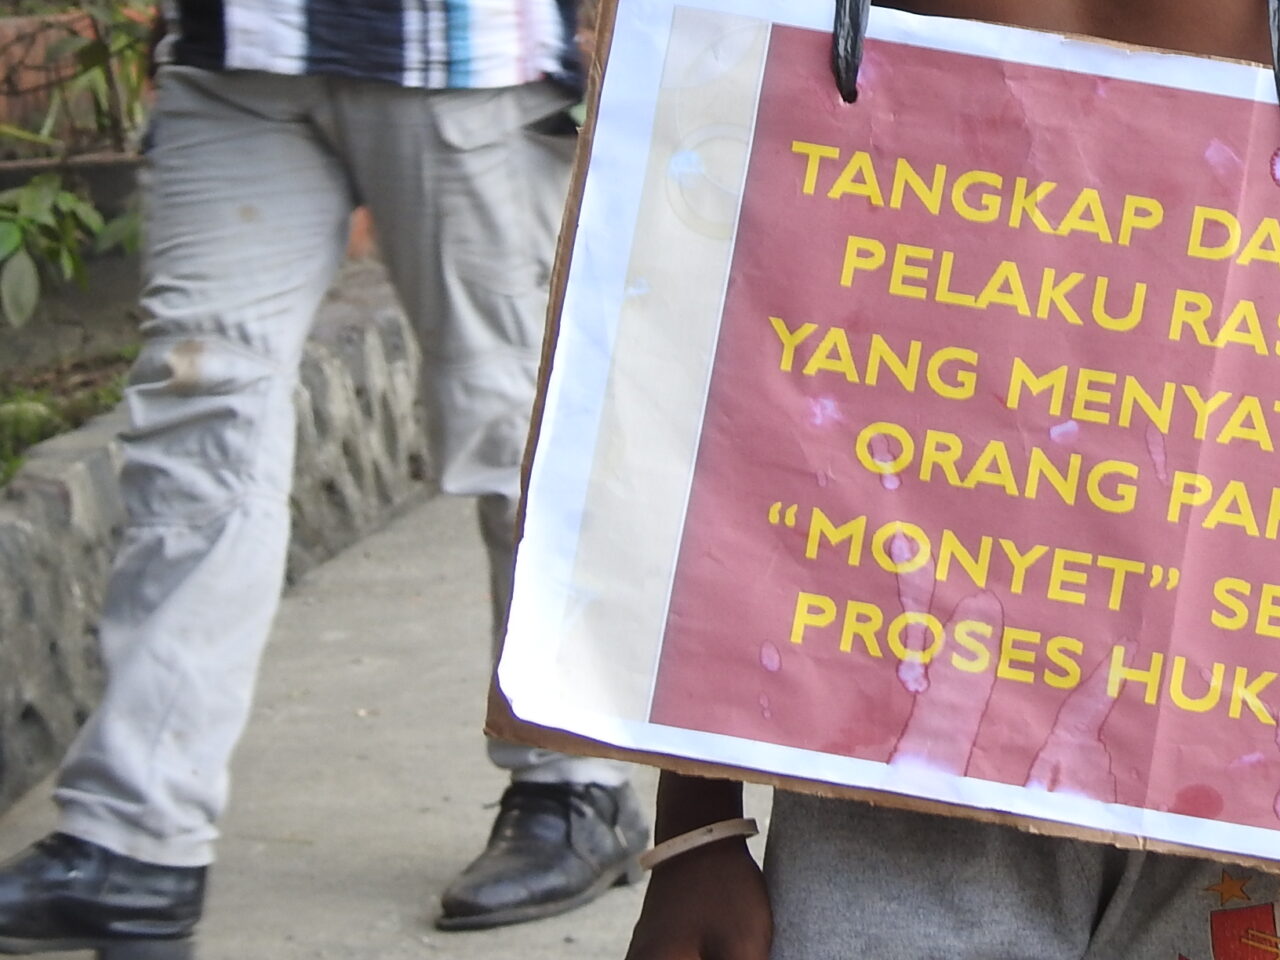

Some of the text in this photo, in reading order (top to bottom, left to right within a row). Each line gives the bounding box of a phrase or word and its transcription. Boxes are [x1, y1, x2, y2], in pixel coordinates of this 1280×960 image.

[791, 141, 1164, 246] TANGKAP
[840, 236, 1147, 332] PELAKU
[770, 317, 979, 400] YANG
[855, 421, 1139, 513] ORANG
[768, 503, 1181, 611] “MONYET”
[790, 592, 1083, 689] PROSES
